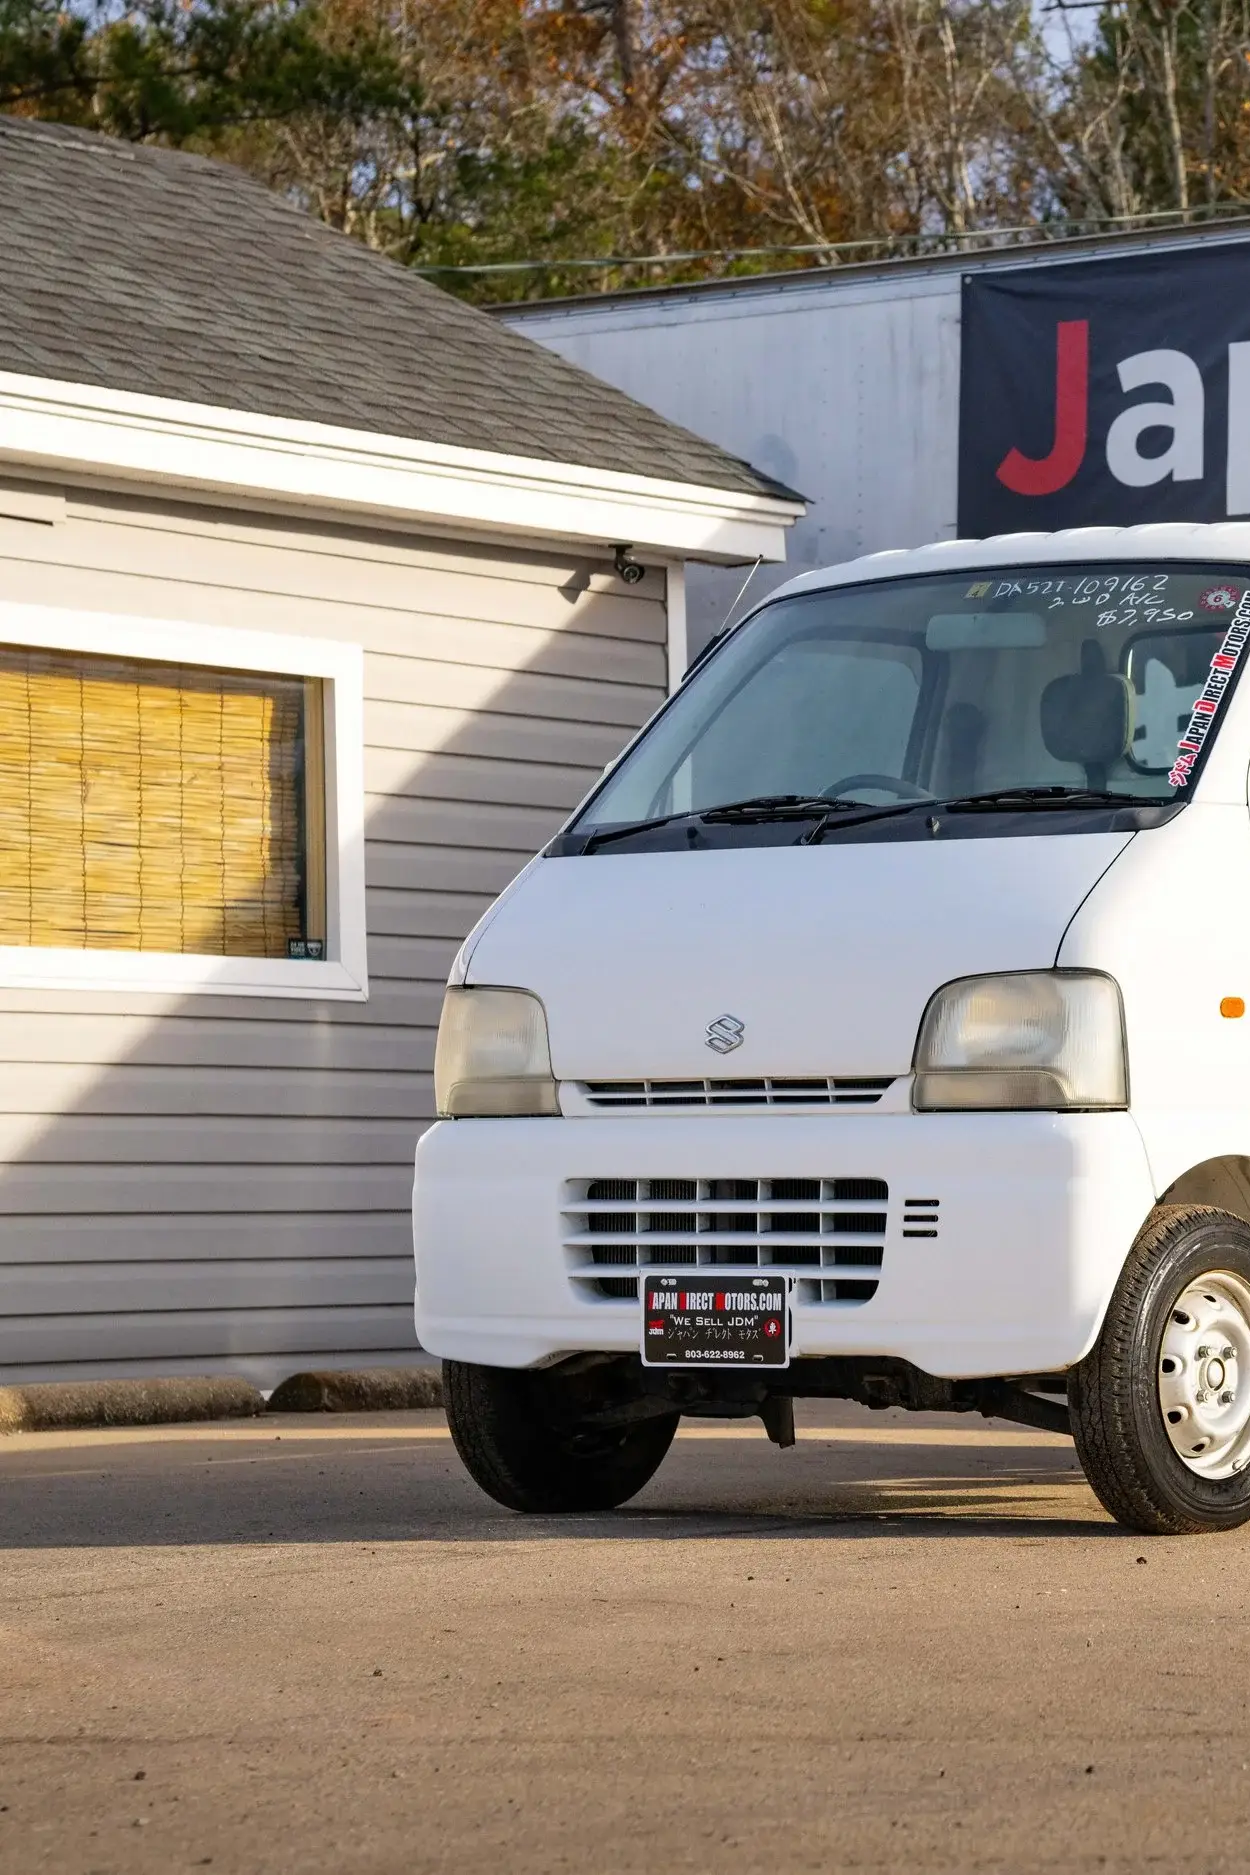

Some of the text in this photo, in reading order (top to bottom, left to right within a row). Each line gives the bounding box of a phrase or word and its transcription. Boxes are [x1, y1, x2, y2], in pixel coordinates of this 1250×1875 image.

[1119, 593, 1164, 605] A/C
[1097, 608, 1194, 626] $7,950
[685, 1349, 745, 1359] 803-622-8962
